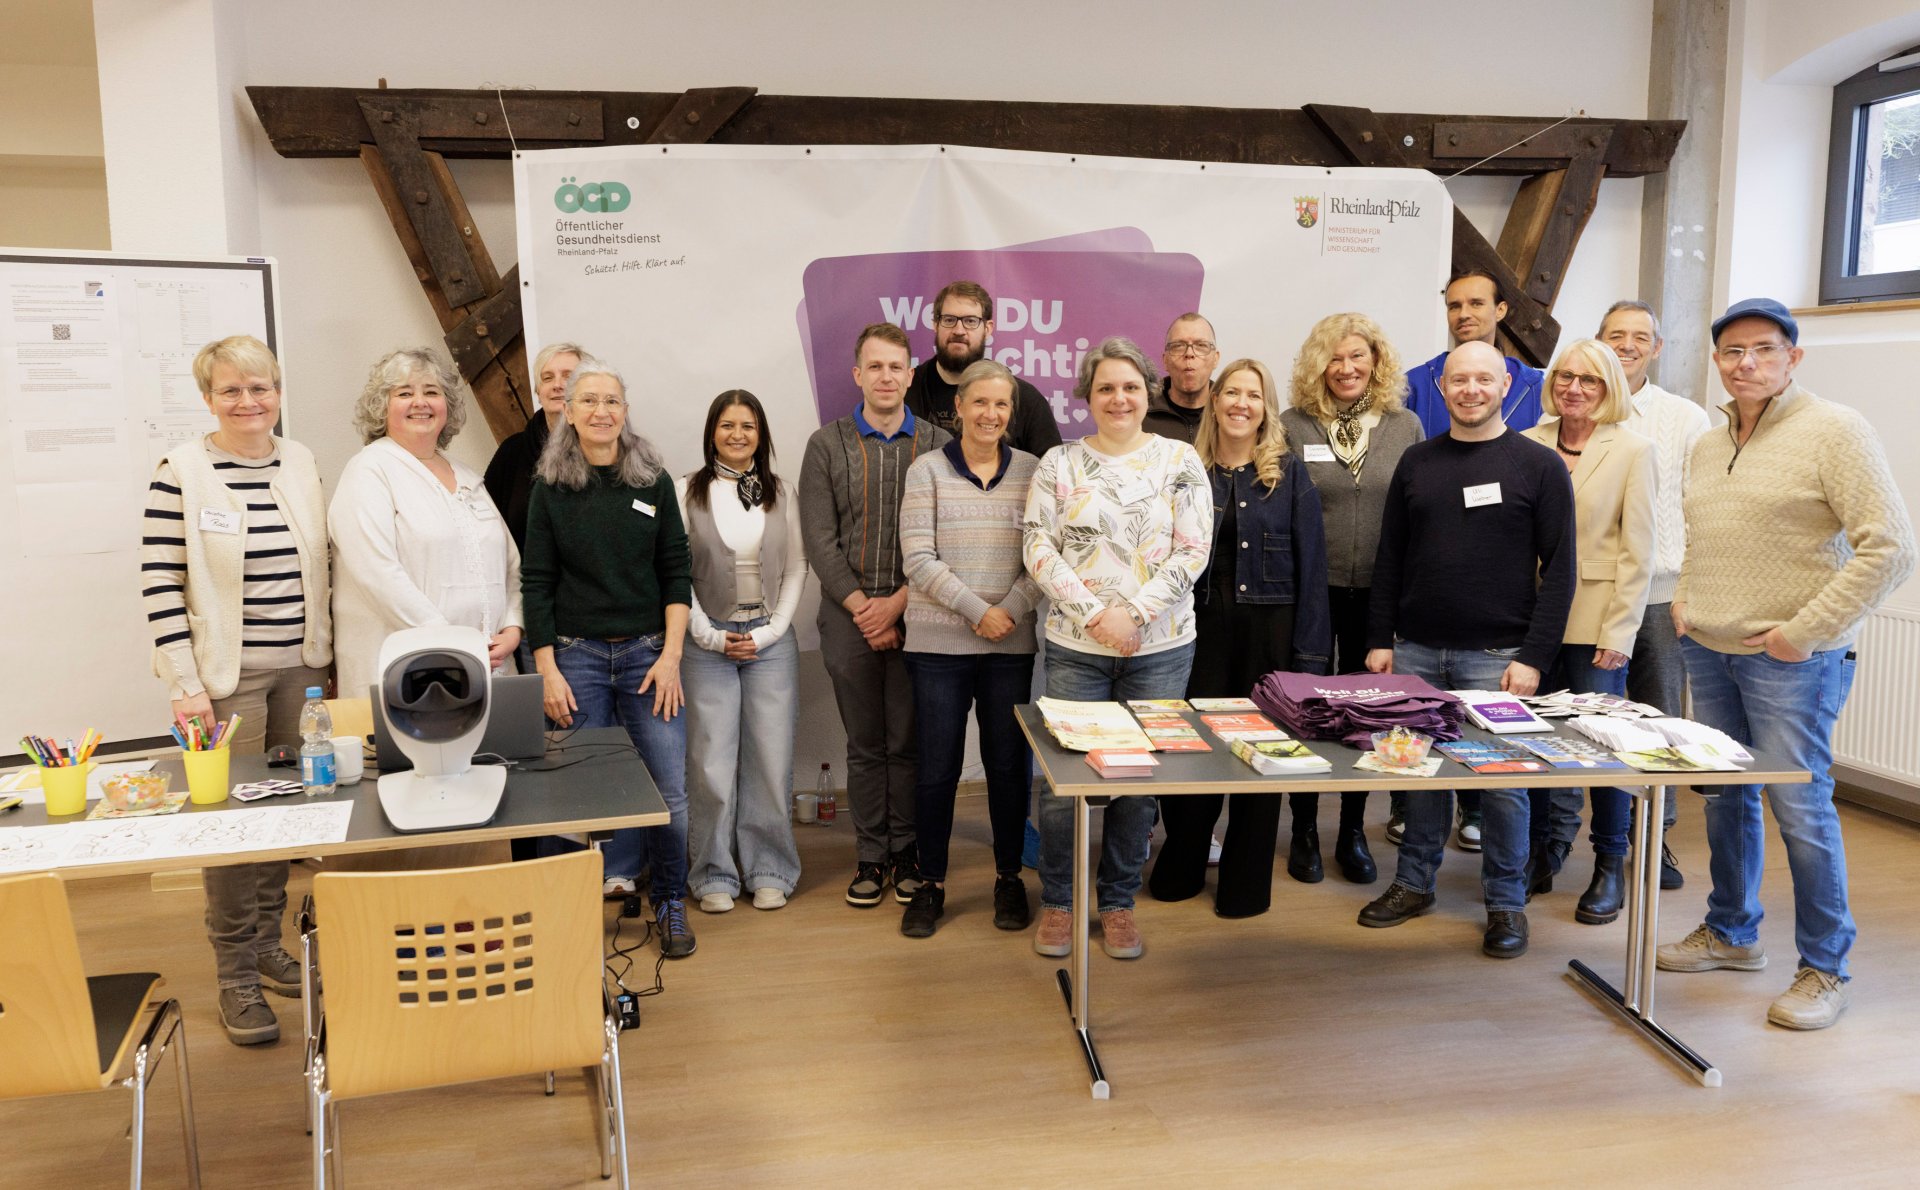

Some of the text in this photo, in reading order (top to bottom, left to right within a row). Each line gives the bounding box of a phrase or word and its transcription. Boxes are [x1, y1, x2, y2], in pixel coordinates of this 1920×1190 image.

[556, 218, 624, 231] Öffentlicher
[1328, 226, 1368, 235] MINISTERIUM
[556, 233, 661, 246] Gesundheitsdienst
[1327, 236, 1374, 244] WISSENSCHAFT
[557, 247, 619, 256] Rheinland-Pfalz
[645, 258, 667, 269] Klärt
[996, 297, 1063, 334] DU
